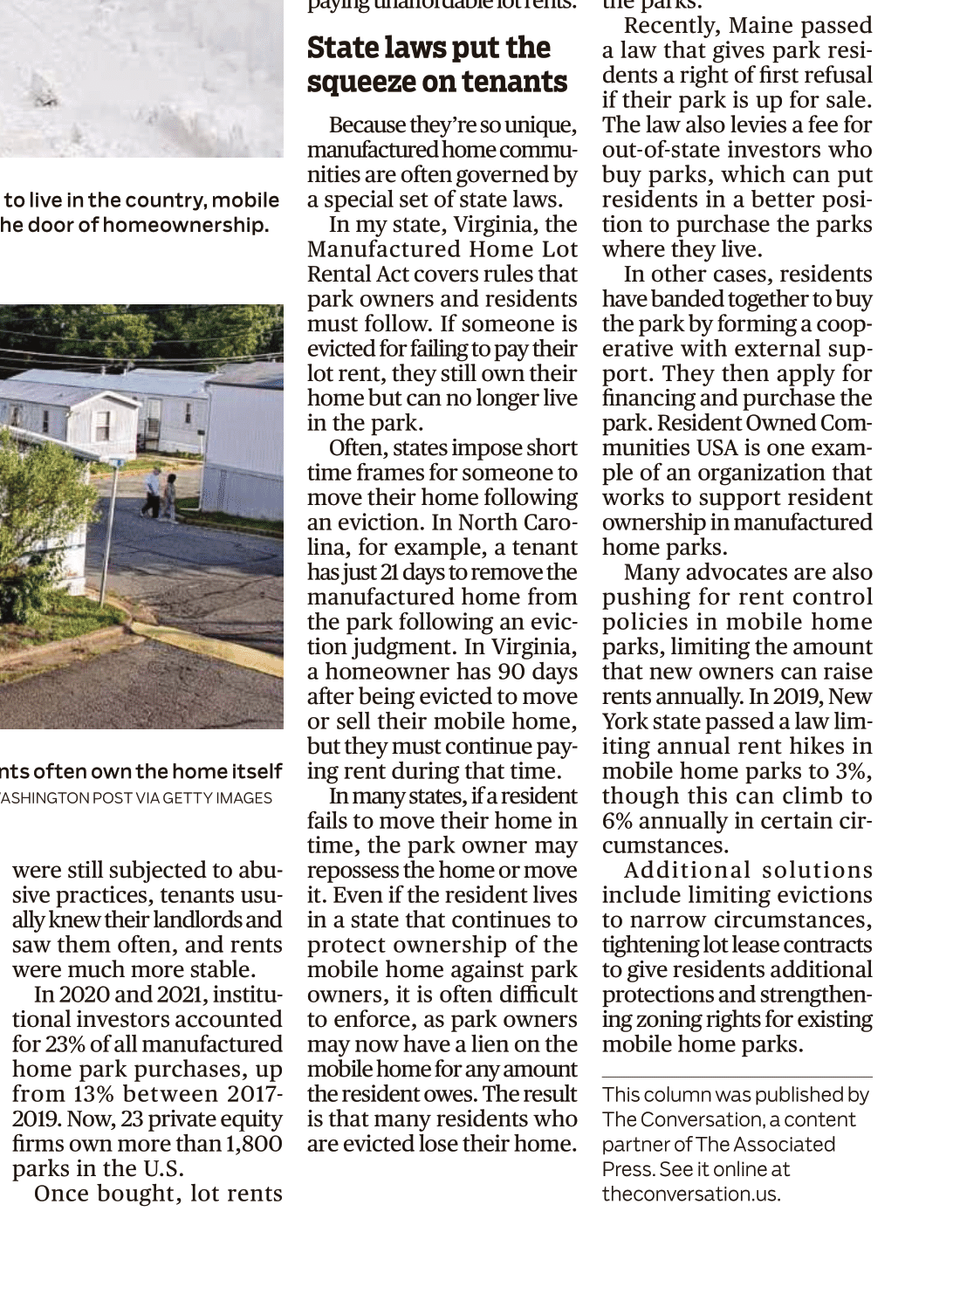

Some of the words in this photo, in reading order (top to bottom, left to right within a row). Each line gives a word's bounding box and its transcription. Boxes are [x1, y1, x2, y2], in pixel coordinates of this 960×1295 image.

[308, 36, 379, 58] State
[385, 35, 447, 58] laws
[452, 37, 499, 63] put
[506, 35, 551, 58] the
[308, 75, 416, 97] squeeze
[422, 75, 456, 92] on
[462, 71, 567, 92] tenants
[93, 792, 133, 804] POST
[136, 792, 160, 804] VIA
[163, 792, 213, 804] GETTY
[217, 792, 272, 804] IMAGES
[603, 812, 632, 830] 6%
[639, 811, 728, 834] annually
[735, 811, 753, 829] in
[761, 811, 832, 829] certain
[840, 811, 872, 829] cir-
[12, 1110, 61, 1127] 2019.
[68, 1111, 116, 1130] Now,
[121, 1110, 143, 1127] 23
[148, 1110, 216, 1132] private
[221, 1110, 283, 1132] equity
[602, 1186, 780, 1201] theconversation.us.
